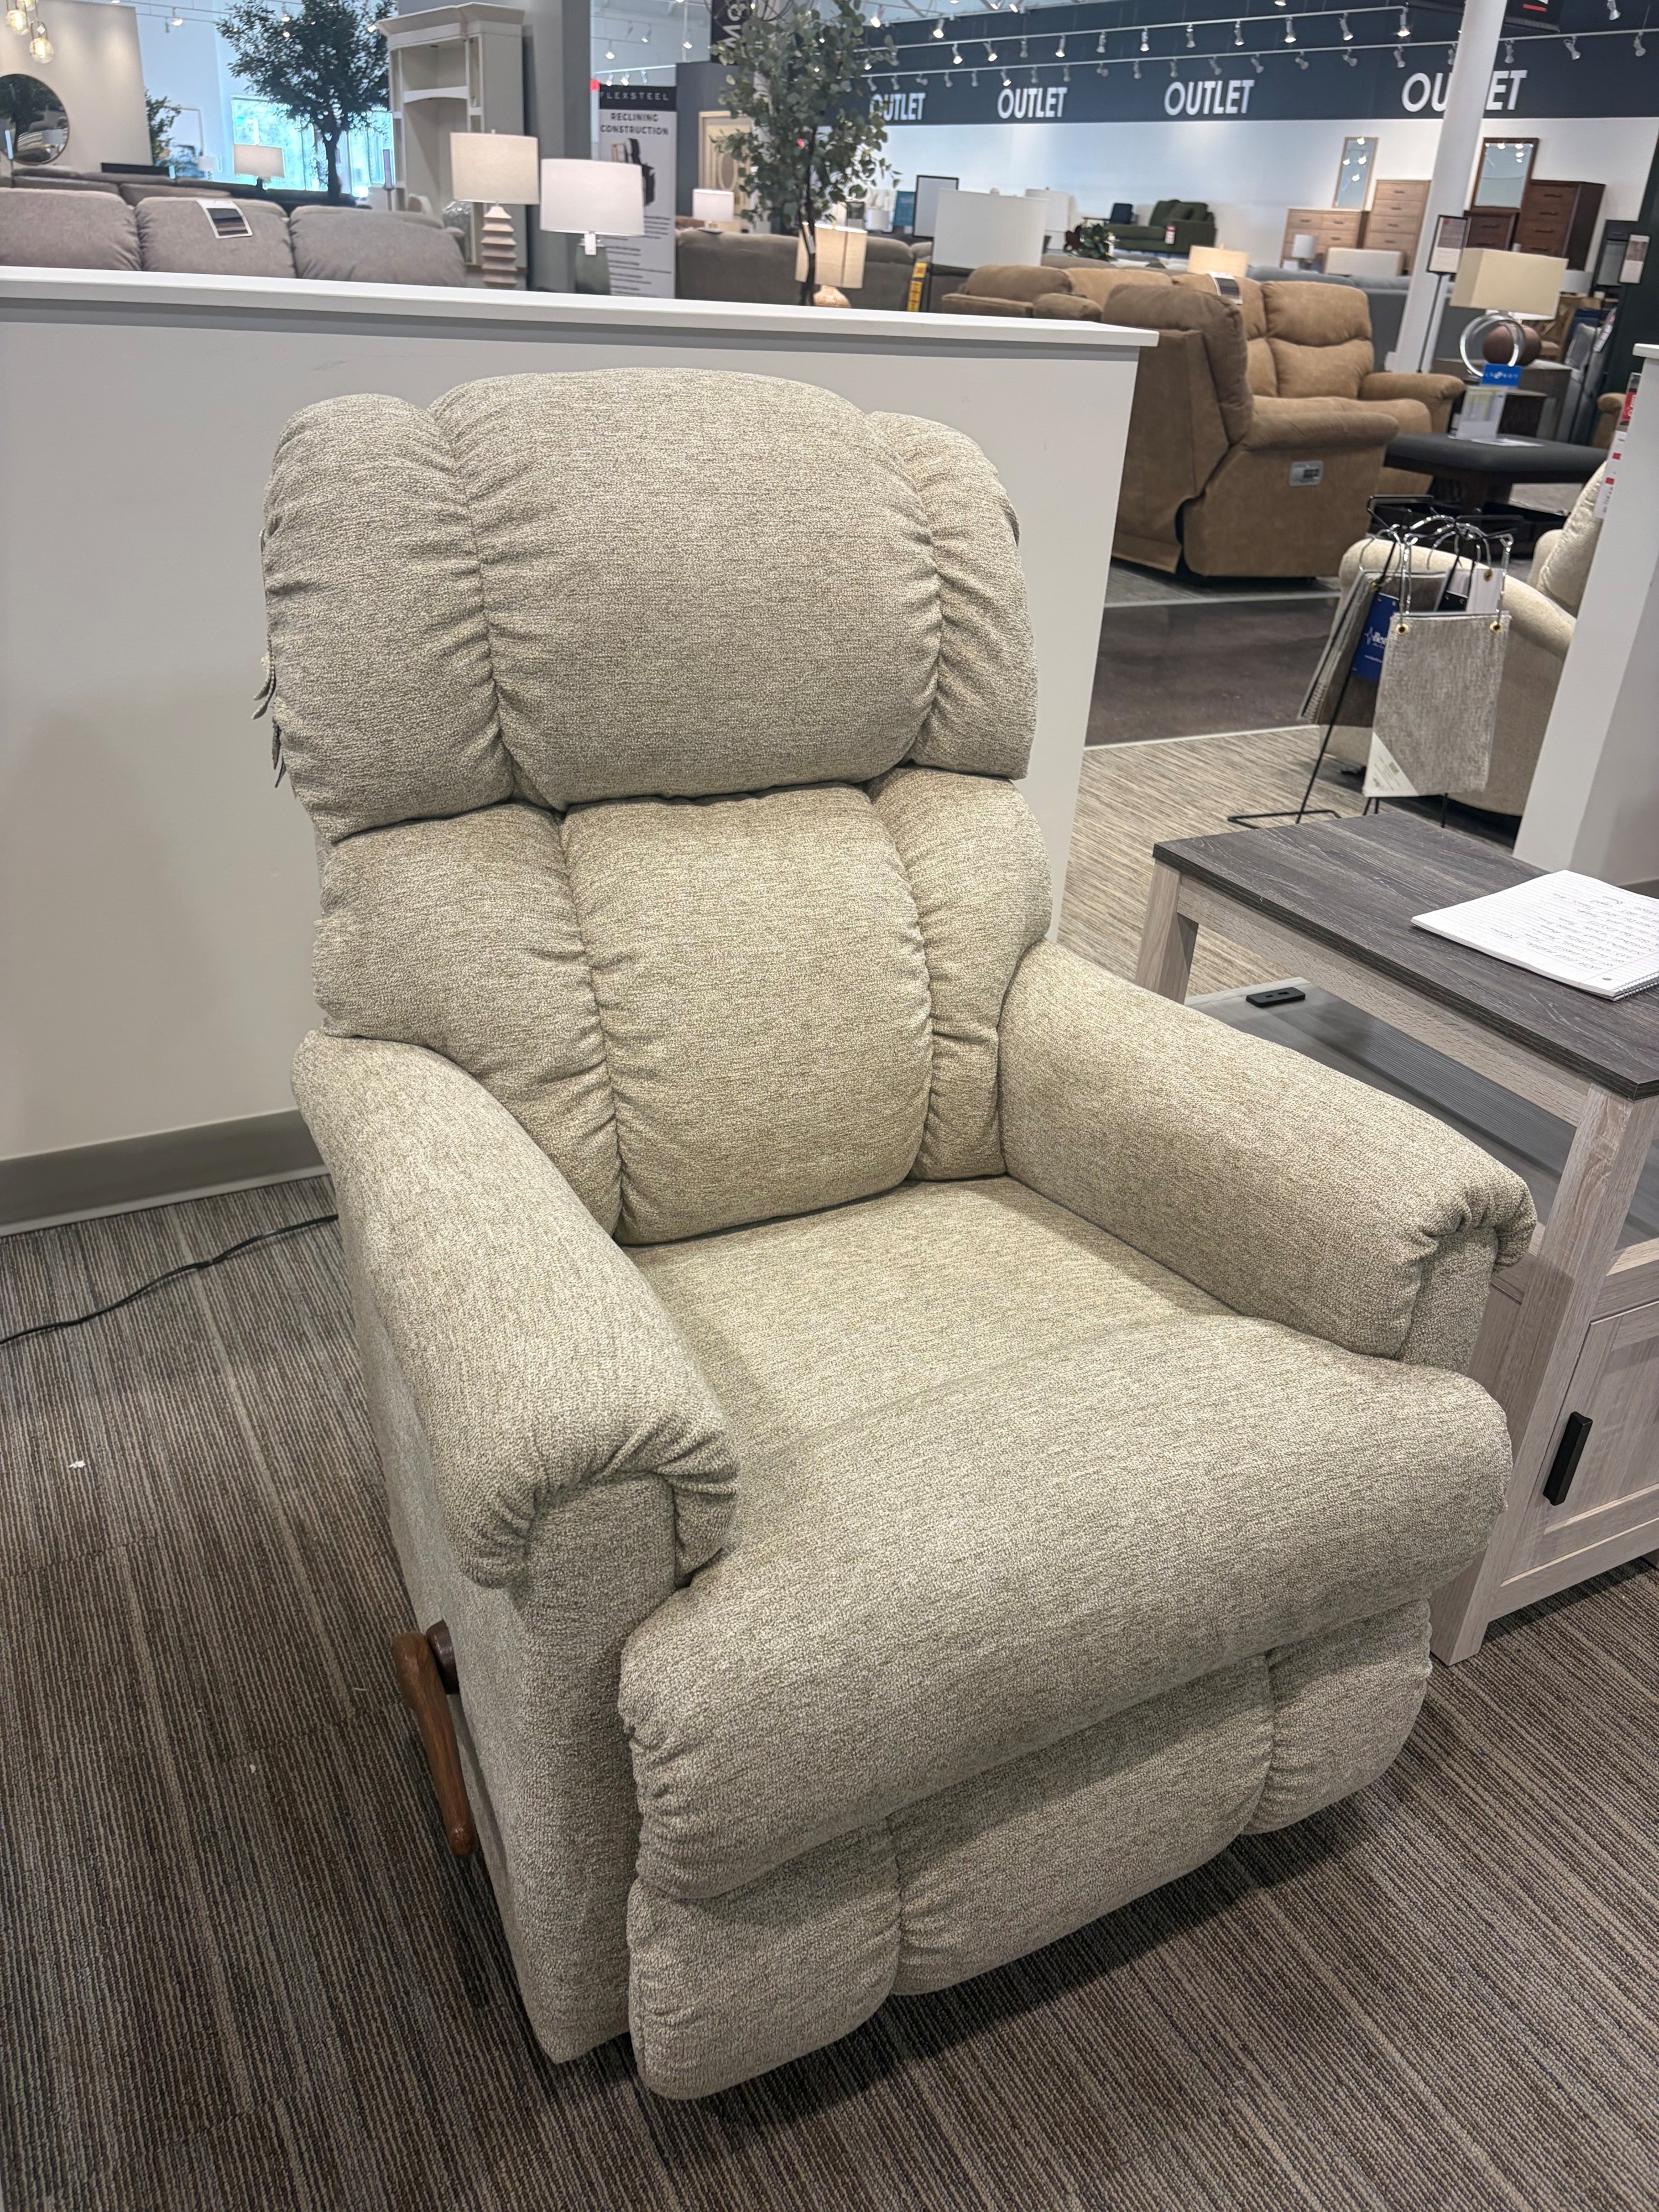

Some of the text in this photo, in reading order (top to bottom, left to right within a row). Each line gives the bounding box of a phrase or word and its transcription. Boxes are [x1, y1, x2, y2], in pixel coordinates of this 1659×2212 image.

[997, 87, 1068, 119] OUTLET
[1164, 79, 1255, 116] OUTLET
[1401, 70, 1528, 112] OUET
[600, 125, 669, 135] CONSTRUCTION
[611, 112, 659, 122] RECLINING
